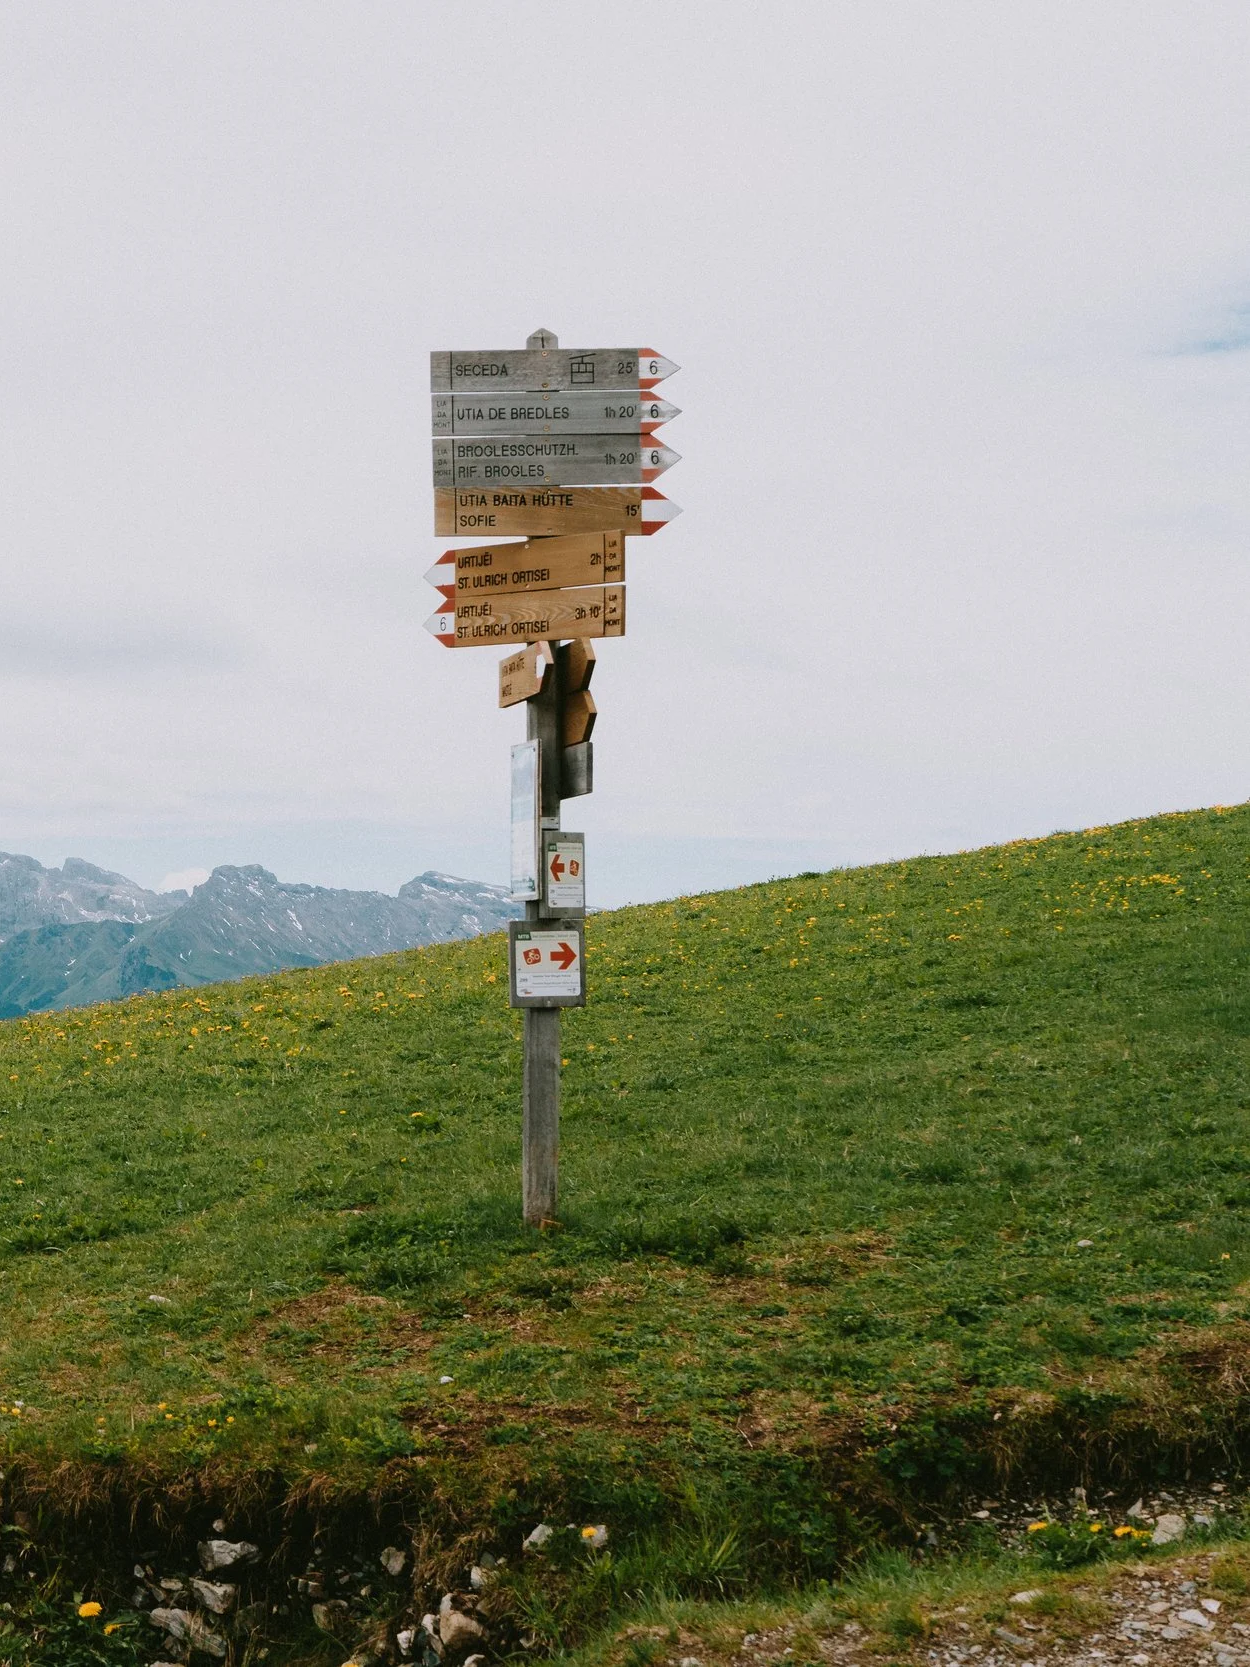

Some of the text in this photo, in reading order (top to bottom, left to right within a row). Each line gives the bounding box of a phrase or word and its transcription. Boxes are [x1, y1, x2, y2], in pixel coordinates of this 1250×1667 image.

[455, 364, 508, 376] SECEDA
[617, 362, 635, 374] 25'
[650, 361, 658, 375] 6
[457, 407, 569, 420] UTIA DE BREDLES
[604, 406, 616, 418] 1h
[650, 404, 659, 418] 6
[457, 444, 579, 457] BROGLESSCHUTZH.
[651, 450, 659, 464] 6
[604, 453, 616, 465] 1h
[458, 465, 545, 478] RIF. BROGLES
[459, 491, 573, 506] UTIA BAITA HÜTTE
[625, 504, 641, 516] 15'
[459, 515, 496, 527] SOFIE
[590, 553, 601, 565] 2h
[457, 569, 550, 589] ST. ULRICH ORTISEI
[574, 607, 586, 620] 3h
[440, 616, 447, 631] 6
[457, 621, 550, 638] ST. ULRICH ORTISEI
